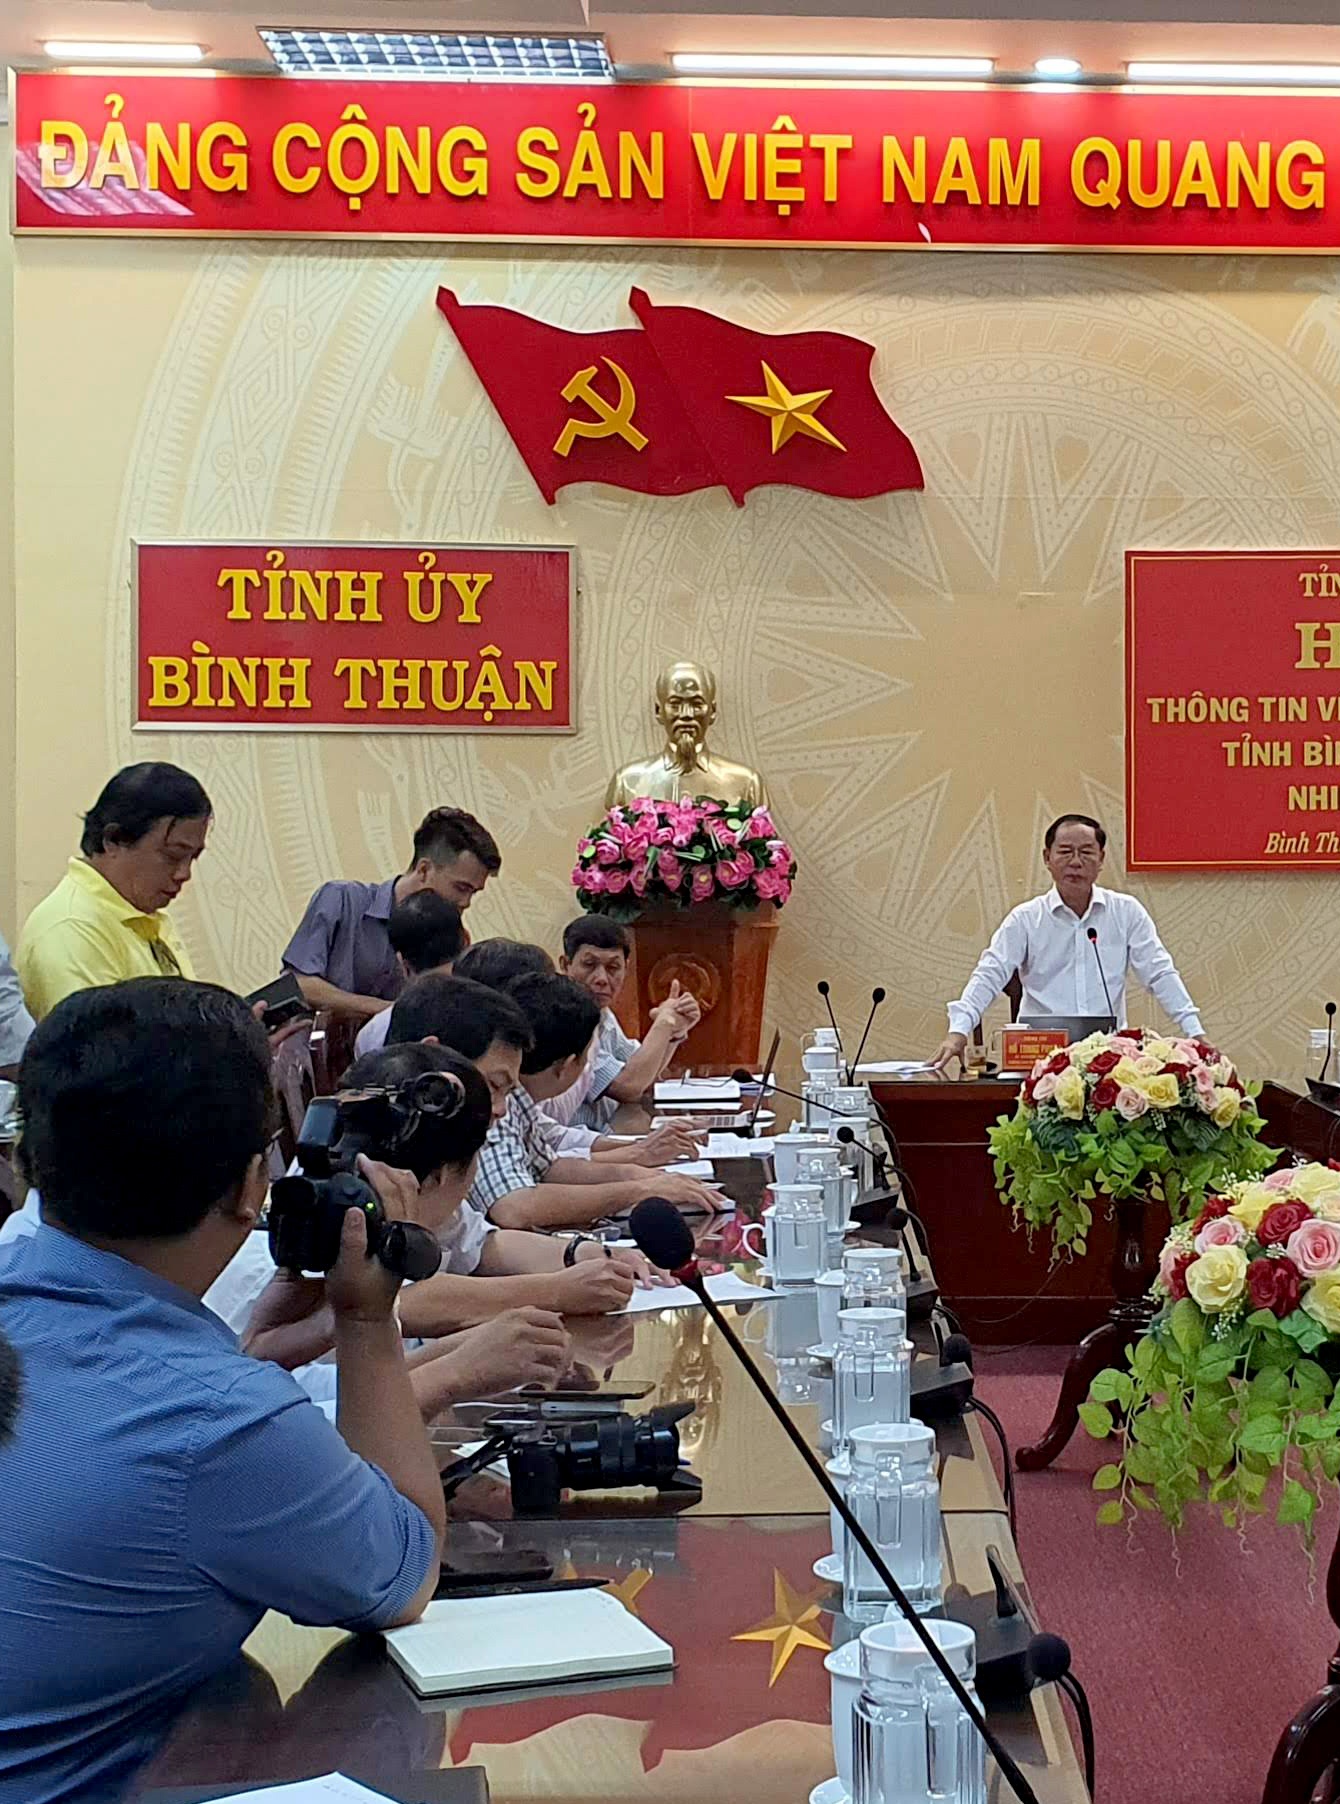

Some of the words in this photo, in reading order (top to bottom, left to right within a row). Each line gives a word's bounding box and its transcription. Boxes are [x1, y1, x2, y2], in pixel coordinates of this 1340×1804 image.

[37, 92, 249, 194] ĐẢNG
[272, 104, 487, 210] CỘNG
[514, 101, 664, 200] SẢN
[692, 115, 852, 215] VIỆT
[882, 133, 1041, 207] NAM
[1070, 137, 1325, 210] QUANG
[216, 549, 383, 622] TỈNH
[403, 551, 493, 623] ỦY
[147, 640, 312, 709] BÌNH
[333, 644, 558, 722] THUẬN
[1146, 691, 1249, 723] THÔNG
[1257, 696, 1307, 722] TIN
[1221, 732, 1292, 767] TỈNH
[1264, 831, 1310, 854] Bình
